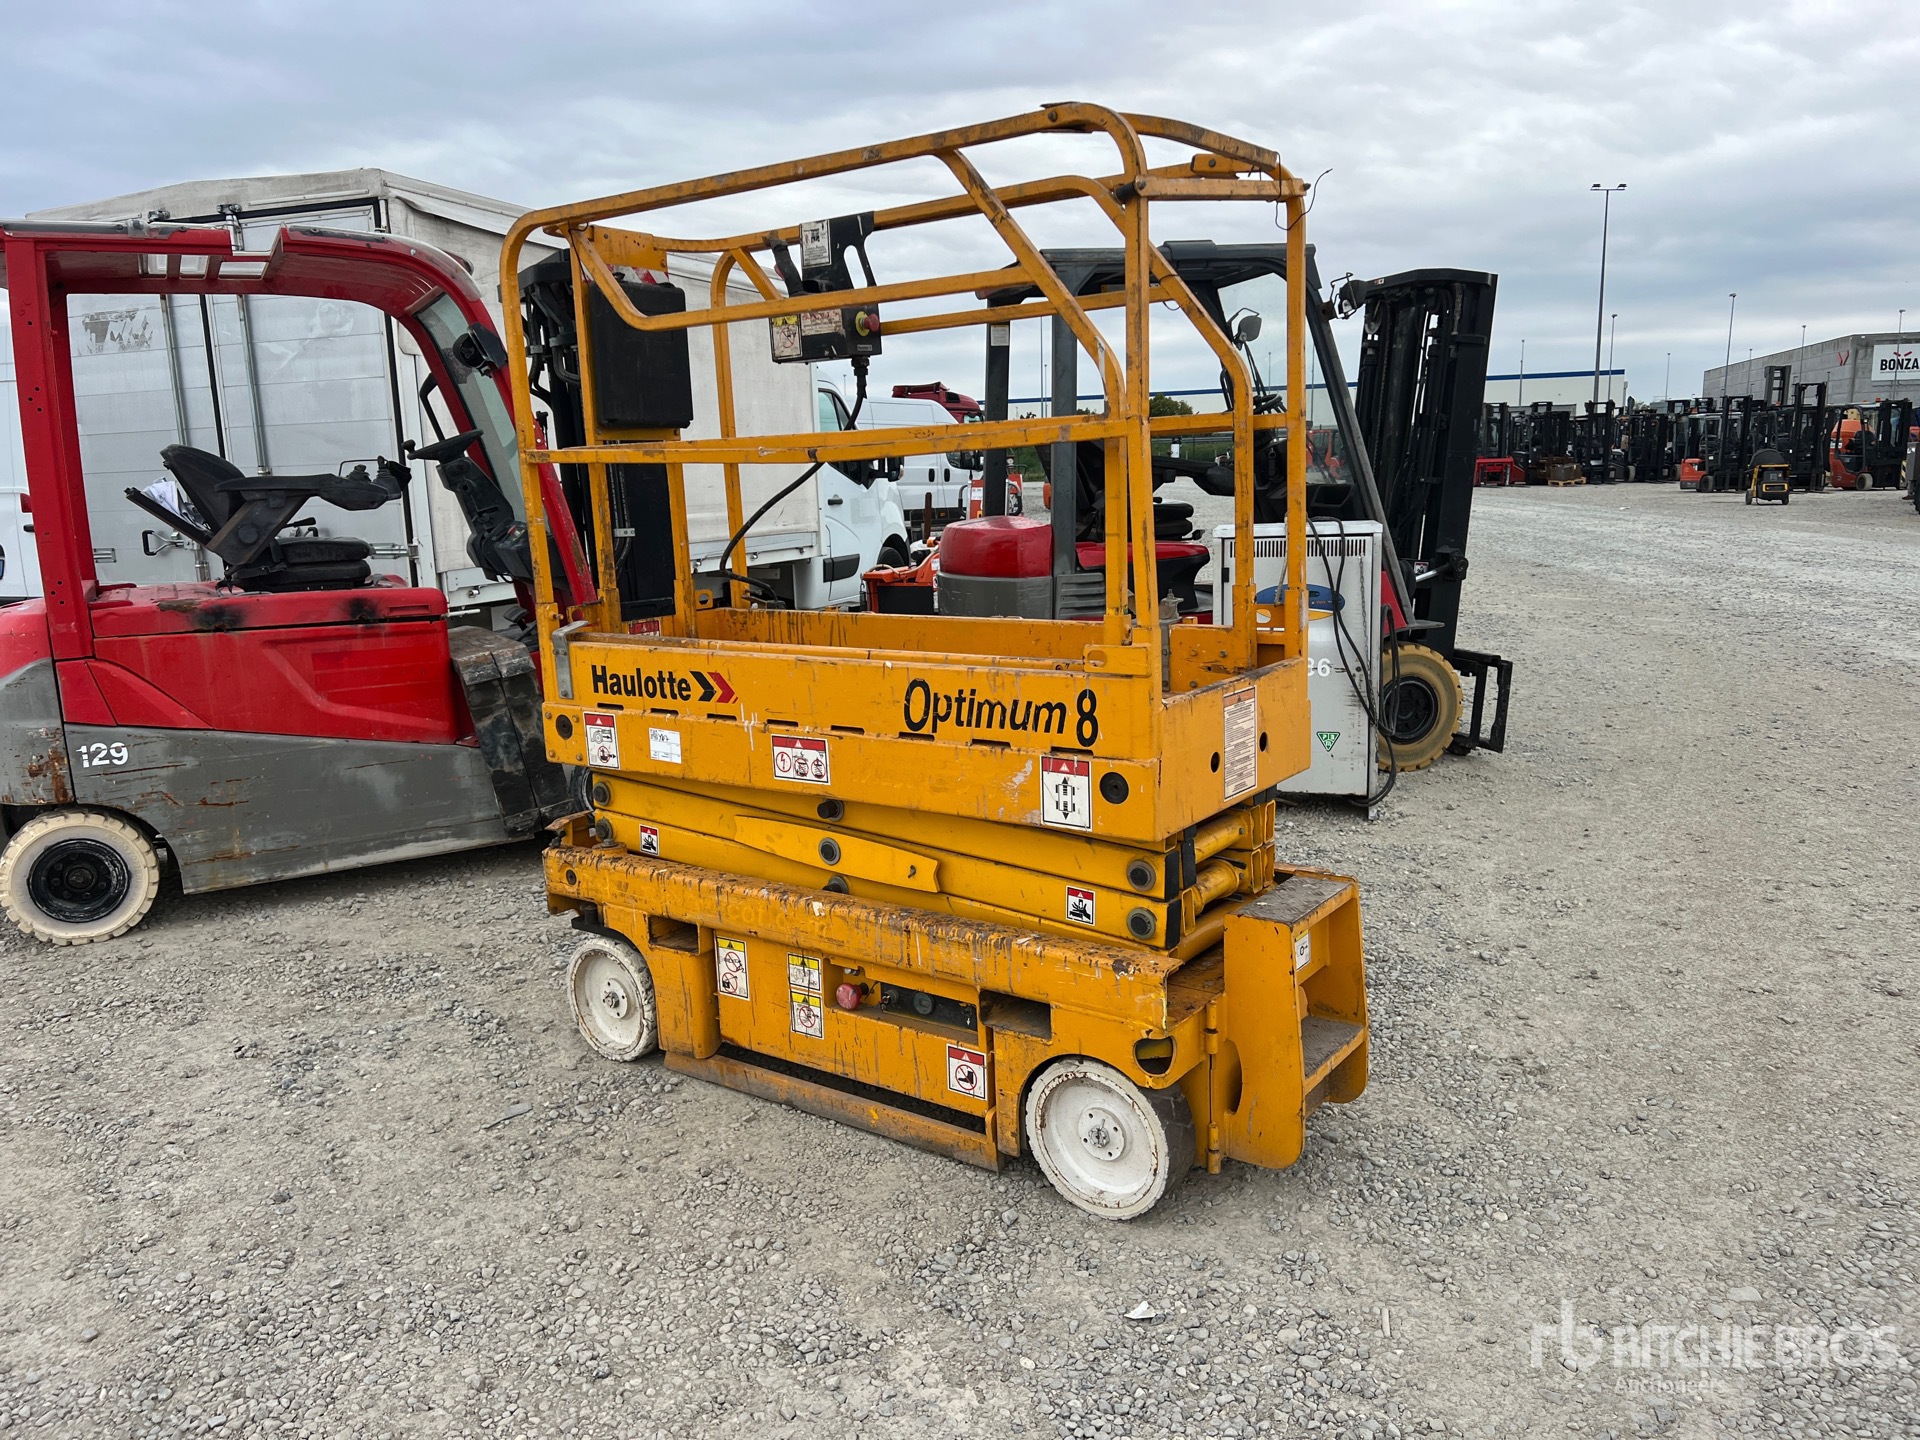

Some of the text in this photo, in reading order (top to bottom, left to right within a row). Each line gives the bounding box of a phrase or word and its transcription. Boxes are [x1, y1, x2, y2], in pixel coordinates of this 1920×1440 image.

[1880, 358, 1919, 370] BONZA
[591, 664, 692, 702] Haulotte
[904, 678, 1099, 748] Optimum 8
[76, 741, 129, 768] 129
